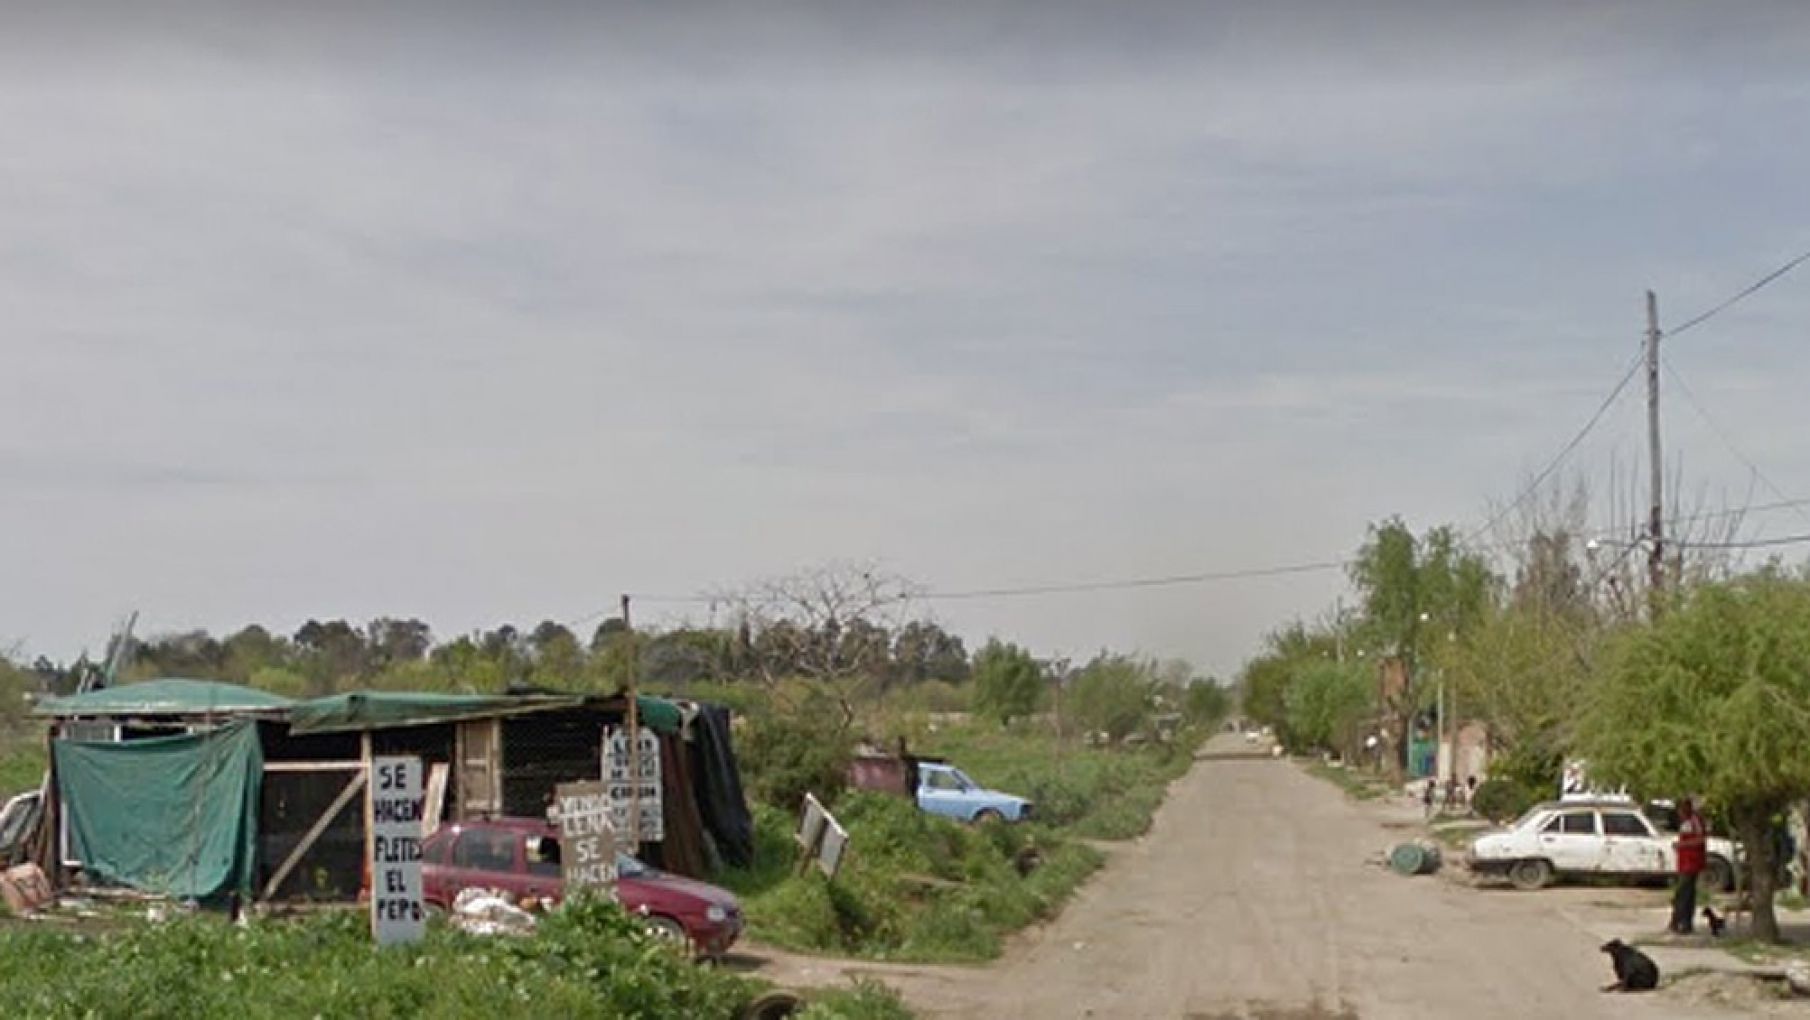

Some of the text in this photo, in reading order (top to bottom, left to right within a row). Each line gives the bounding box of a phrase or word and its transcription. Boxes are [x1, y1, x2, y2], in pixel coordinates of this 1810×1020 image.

[379, 764, 406, 790] SE
[375, 798, 422, 822] HACEN
[576, 838, 601, 862] SE
[386, 868, 406, 892] EL
